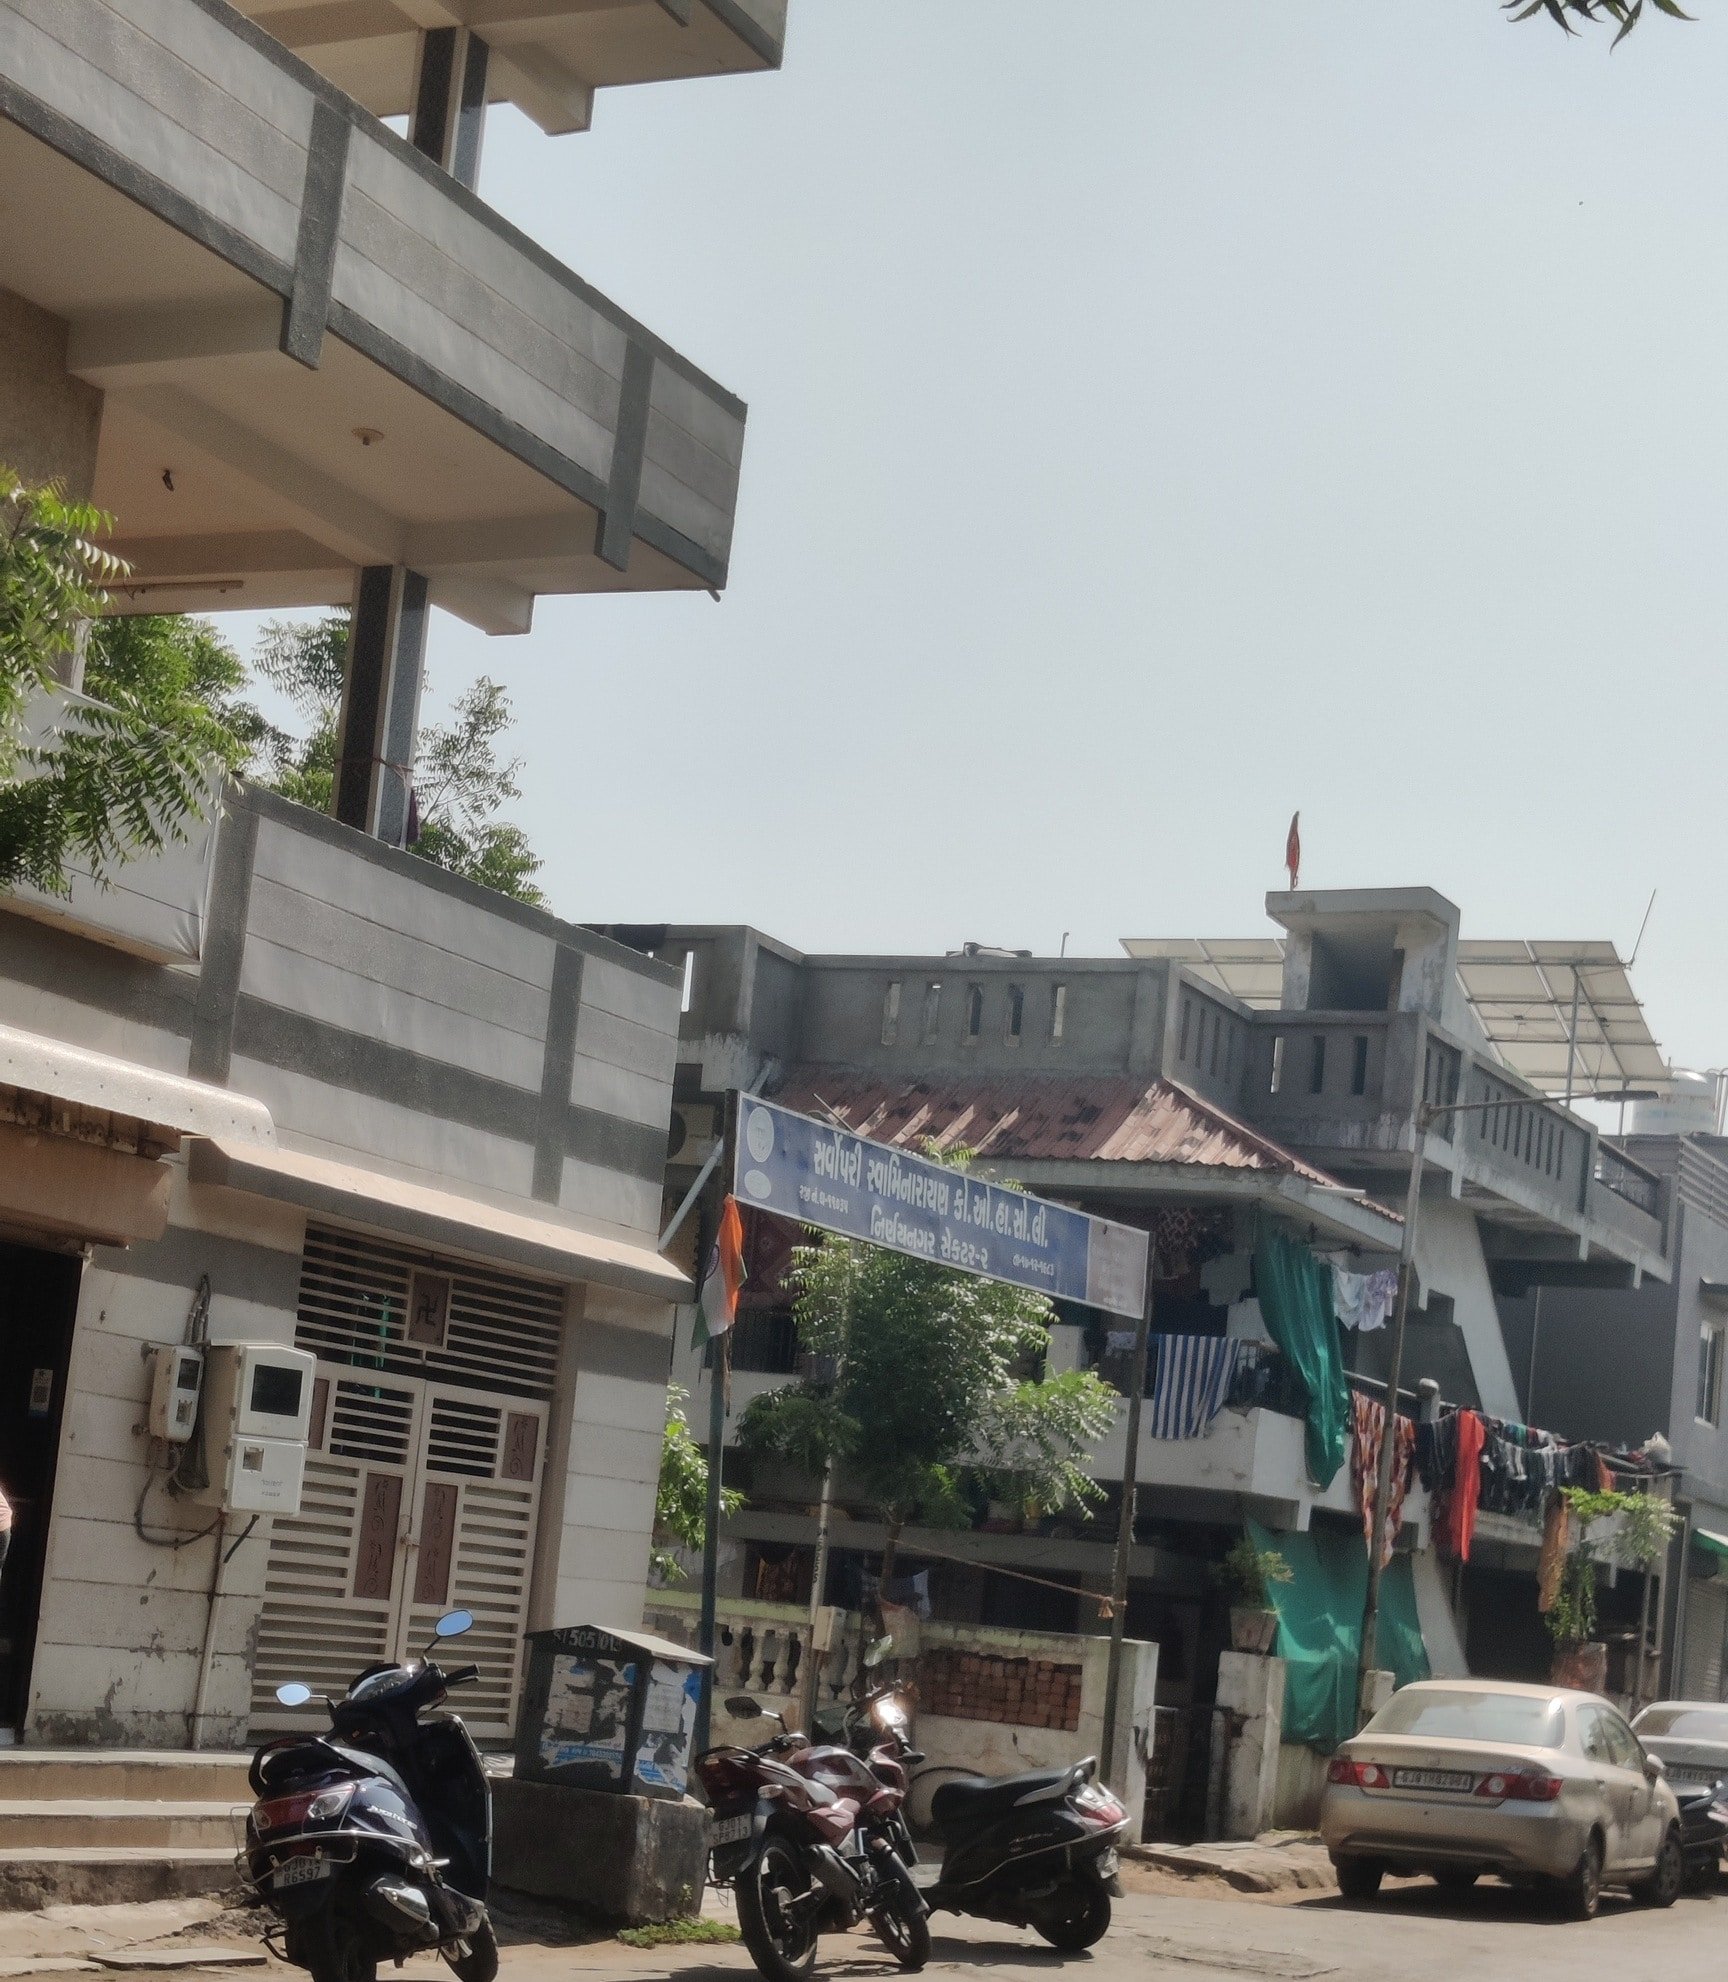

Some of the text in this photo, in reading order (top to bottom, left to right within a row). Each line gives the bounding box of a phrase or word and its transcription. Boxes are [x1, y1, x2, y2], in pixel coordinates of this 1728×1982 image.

[813, 1131, 862, 1188] સર્વોપરી
[866, 1153, 949, 1216] સ્વામિનારાયણ
[870, 1204, 936, 1255] નિર્ણયનગર
